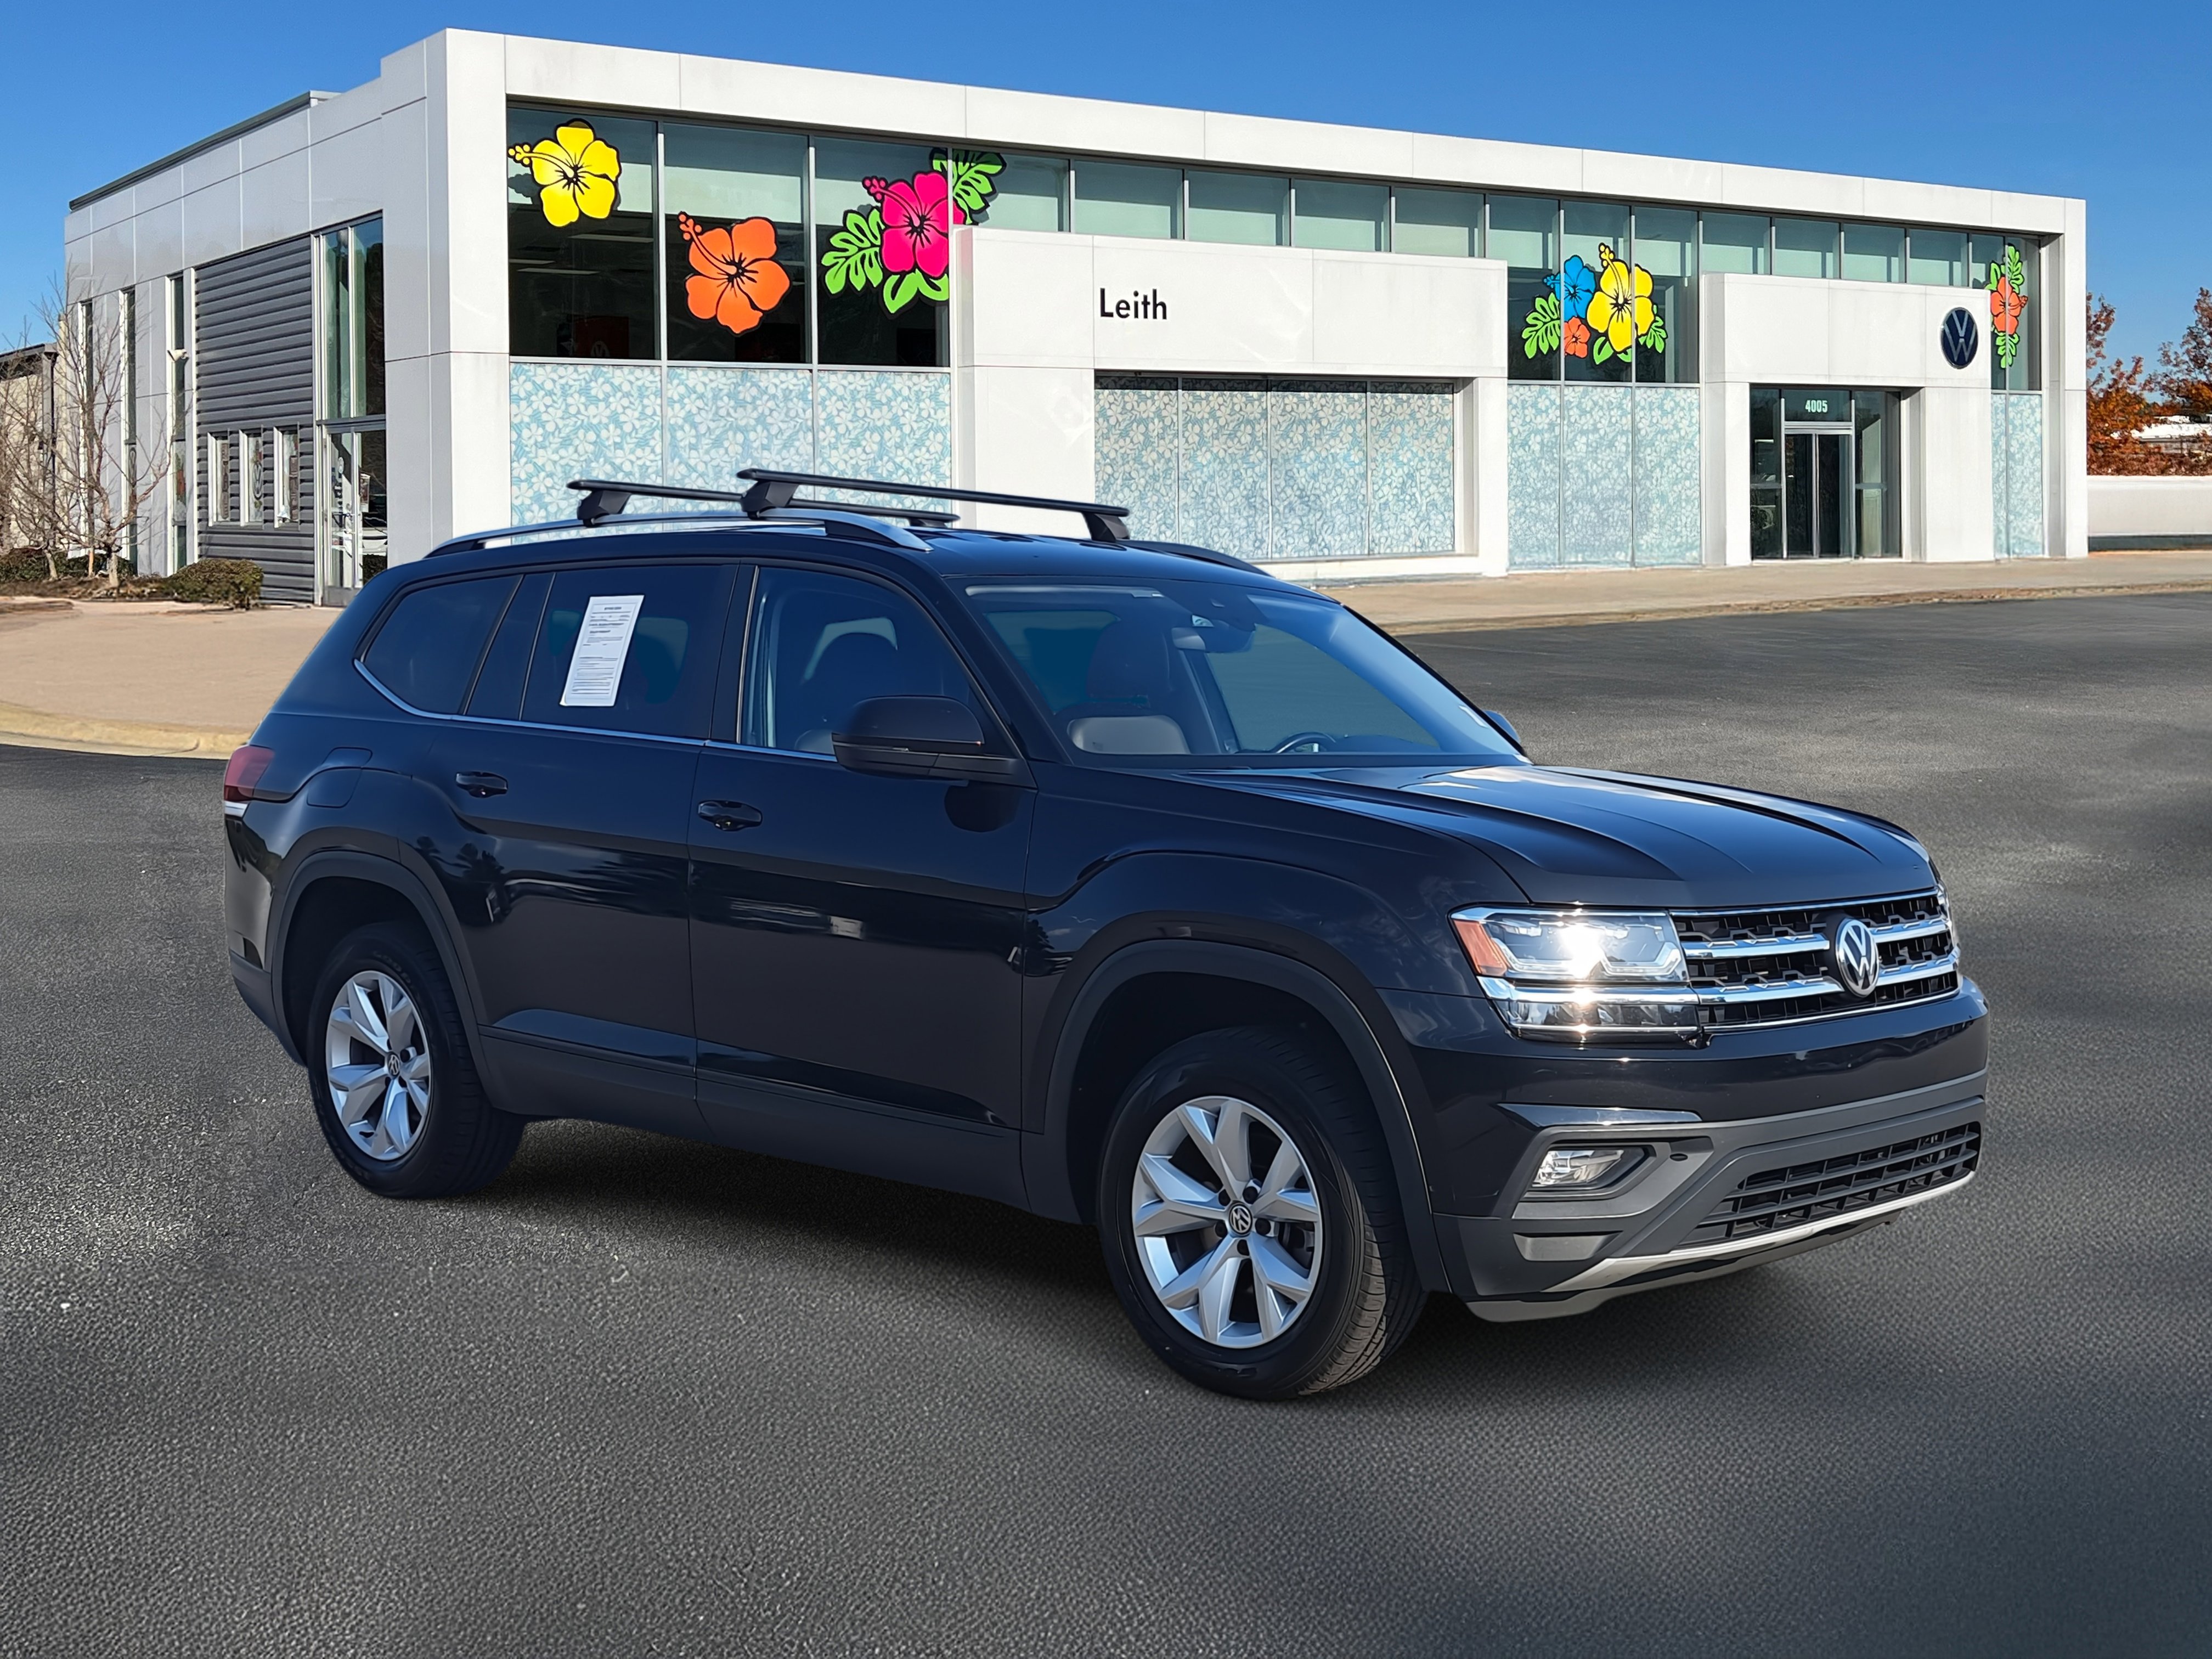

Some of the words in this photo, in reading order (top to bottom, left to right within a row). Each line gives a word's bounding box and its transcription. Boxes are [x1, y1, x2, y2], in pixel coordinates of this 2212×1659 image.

[1100, 288, 1167, 319] Leith
[1942, 308, 1978, 365] VW
[1805, 400, 1827, 413] 4005
[1839, 921, 1877, 994] VW
